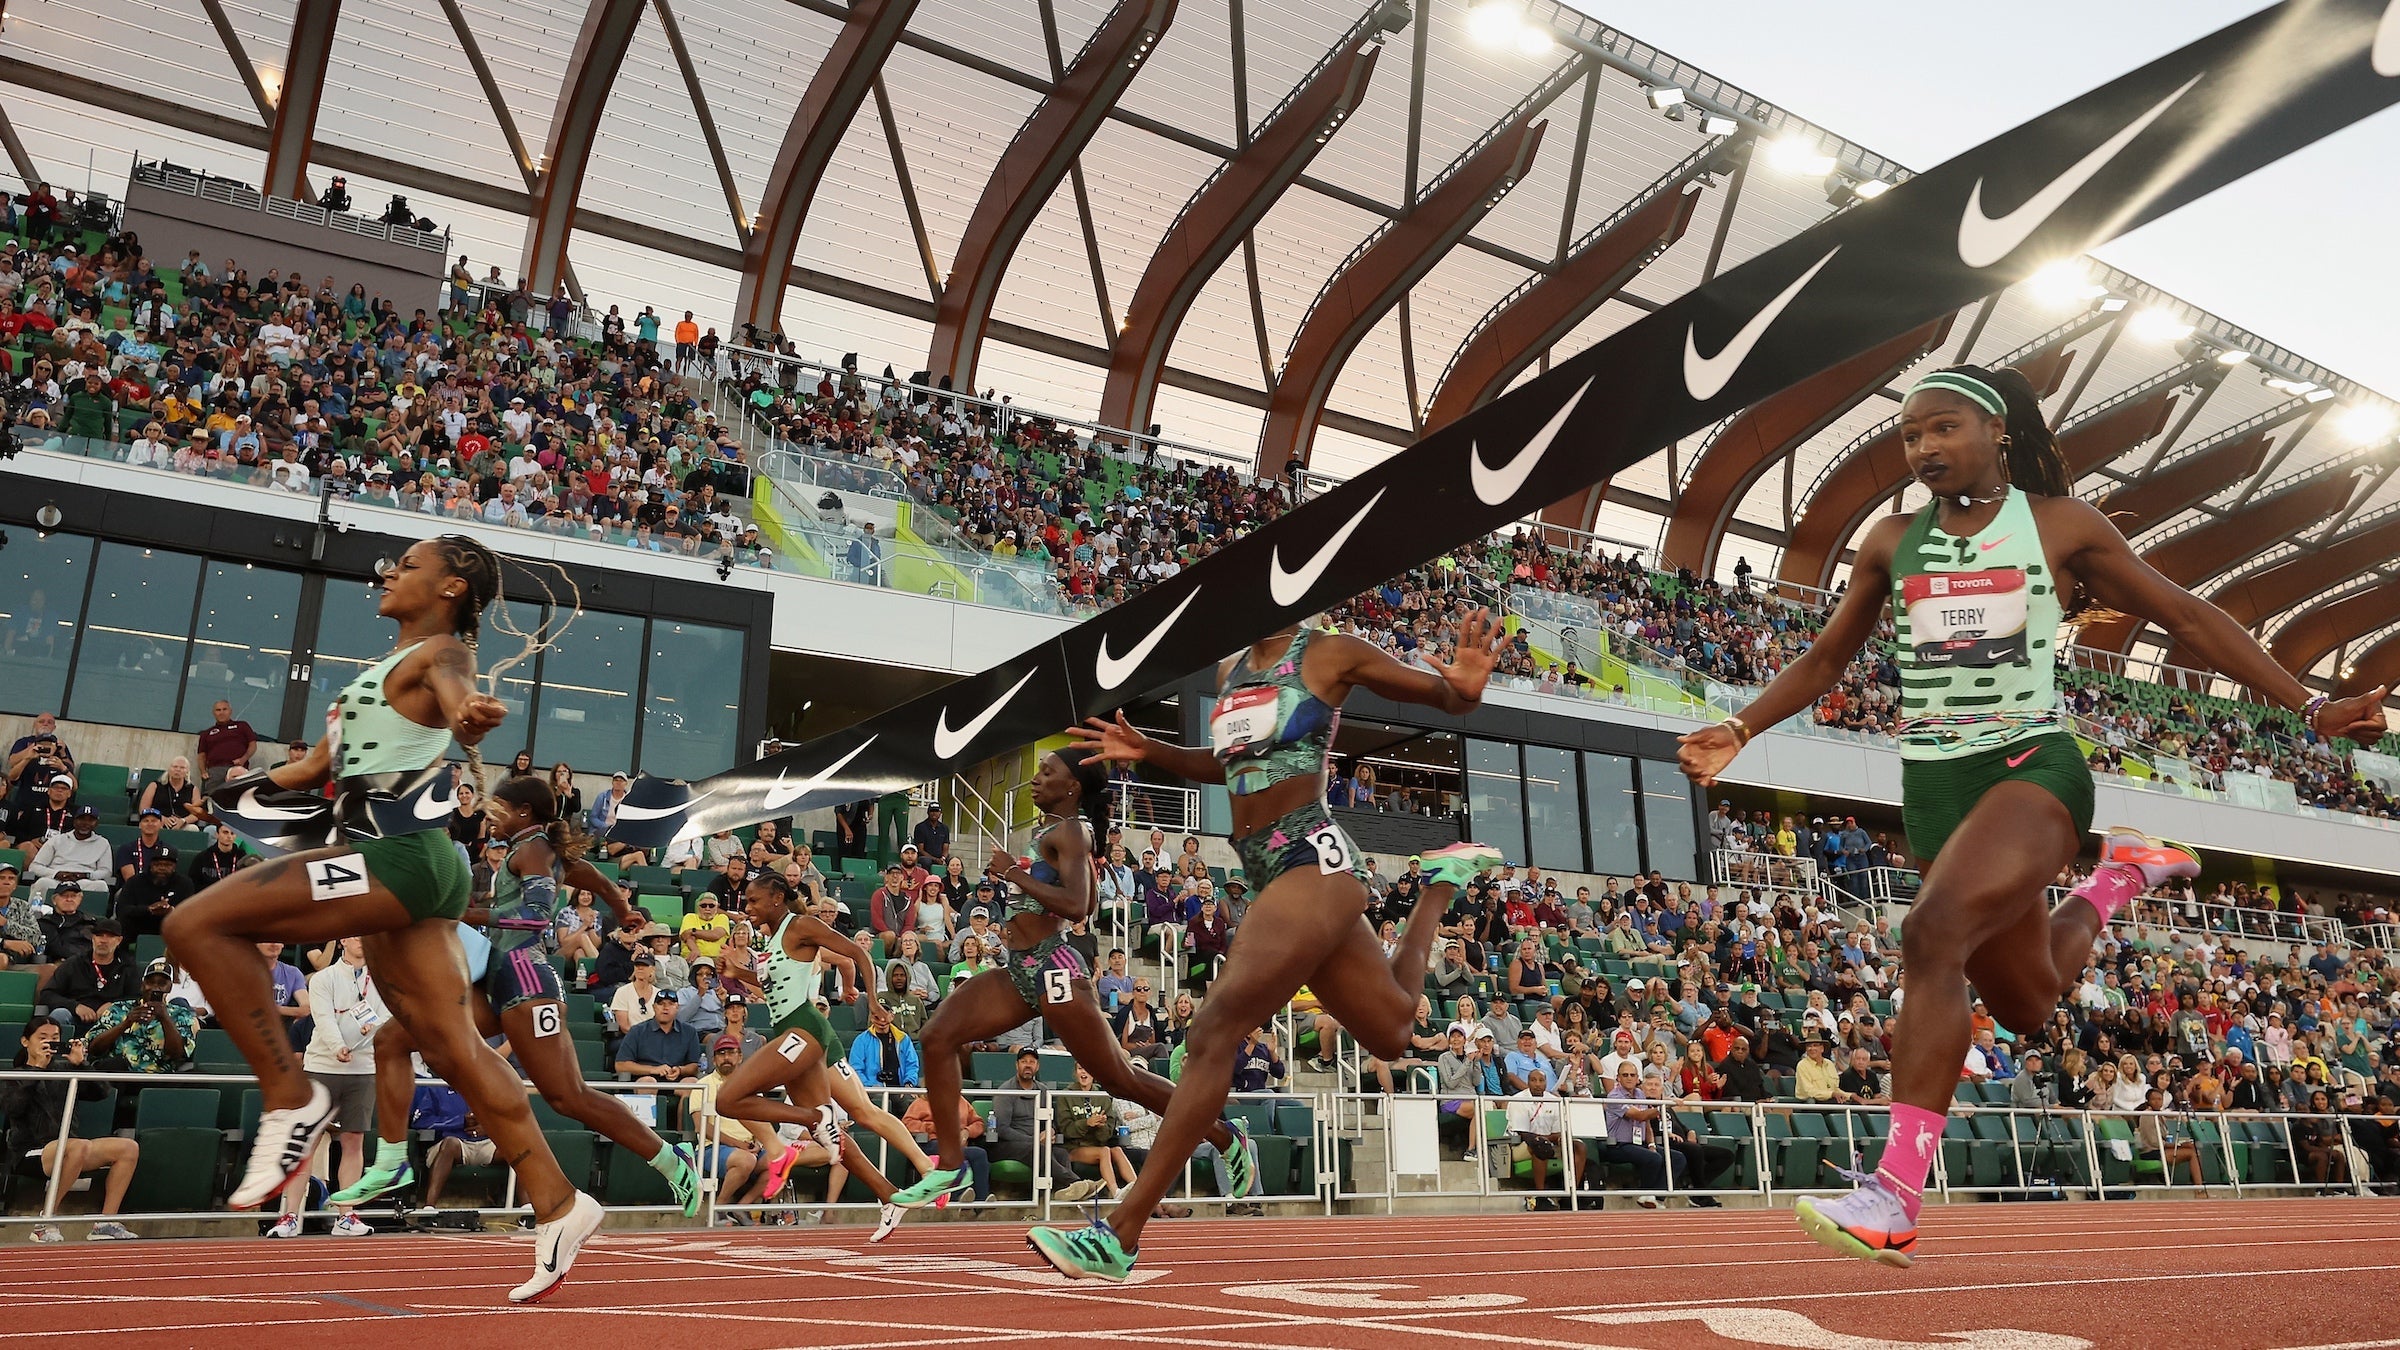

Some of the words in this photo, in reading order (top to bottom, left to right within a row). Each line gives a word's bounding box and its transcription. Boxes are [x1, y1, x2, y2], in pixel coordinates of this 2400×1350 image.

[1951, 578, 1994, 589] TOYOTA
[1941, 608, 1986, 626] TERRY
[1227, 718, 1251, 736] DAVIS
[1317, 832, 1344, 869] 3
[317, 863, 362, 890] 4
[1051, 971, 1066, 1002] 5
[539, 1006, 556, 1033] 6
[784, 1035, 800, 1054] 7
[1219, 1282, 1528, 1310] 3
[1552, 1307, 2096, 1350] 2
